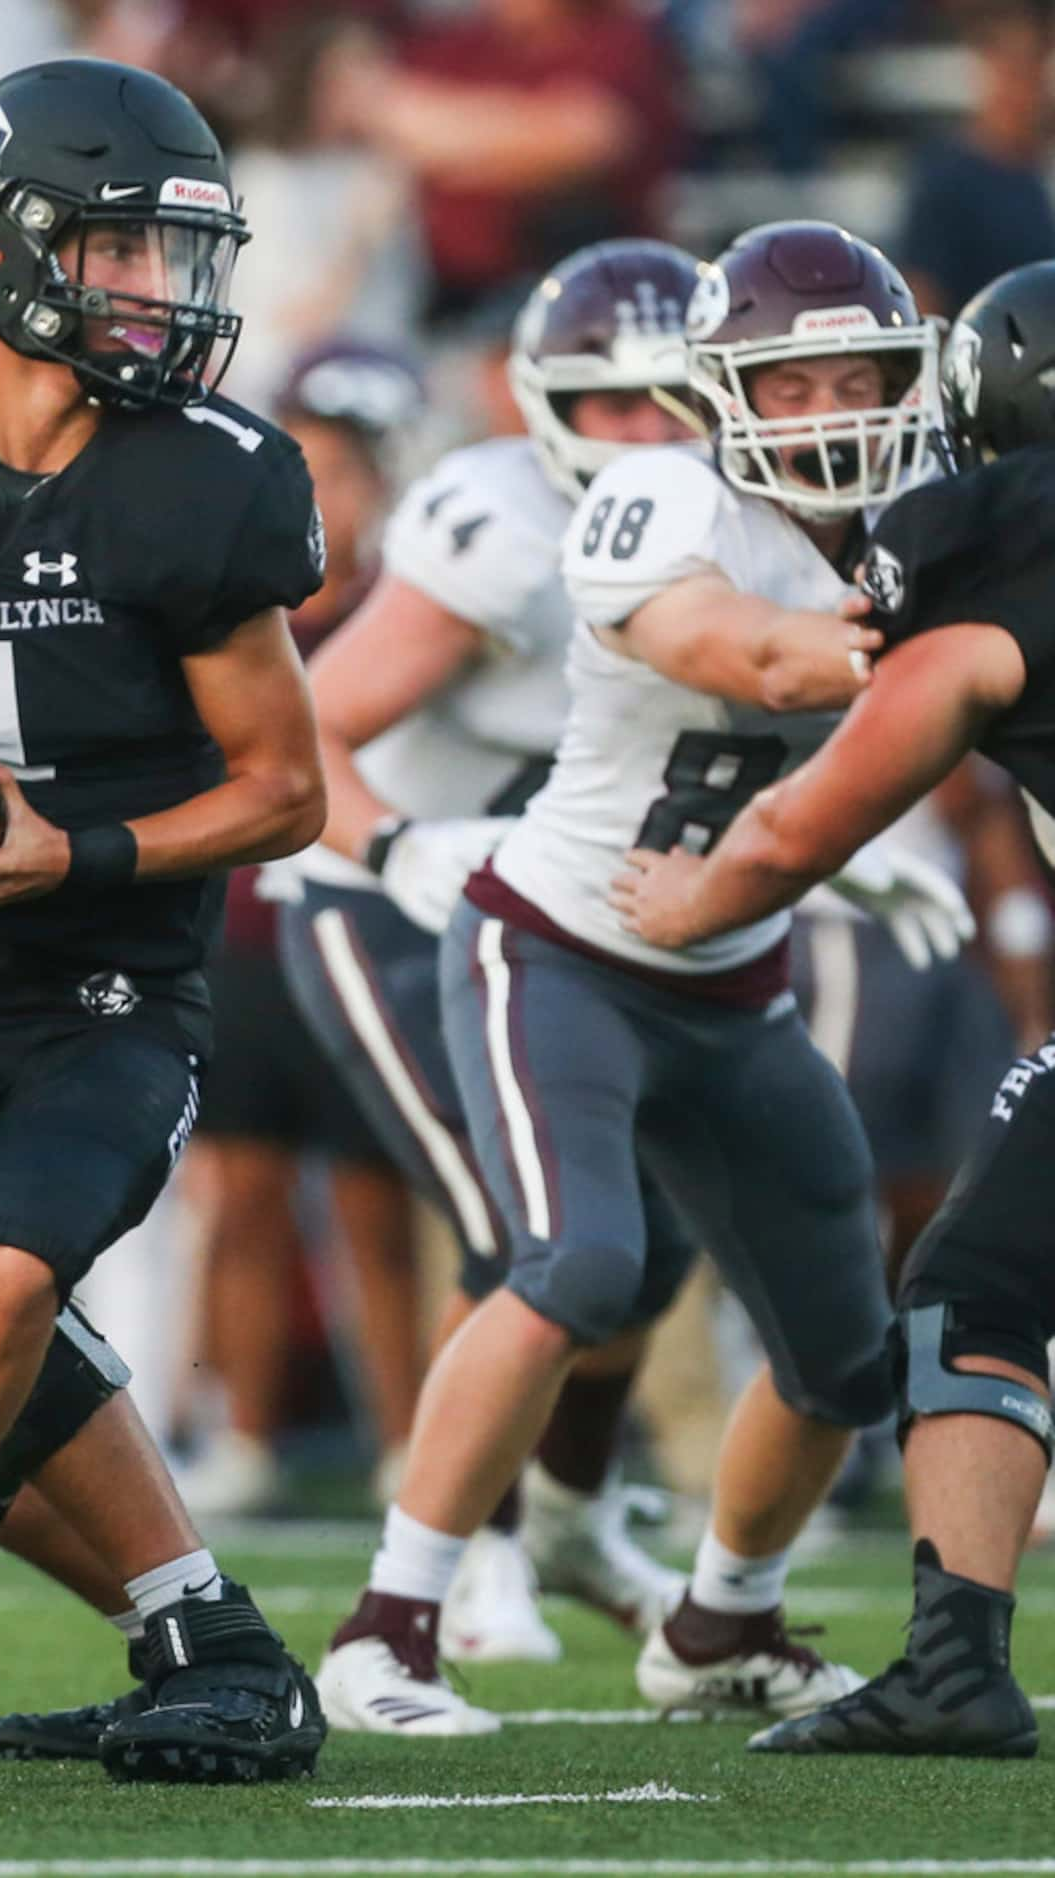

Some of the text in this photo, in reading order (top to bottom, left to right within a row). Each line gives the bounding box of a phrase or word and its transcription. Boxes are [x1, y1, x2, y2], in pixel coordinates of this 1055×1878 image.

[182, 406, 264, 453] 1
[582, 497, 655, 560] 88
[0, 598, 104, 630] LYNCH
